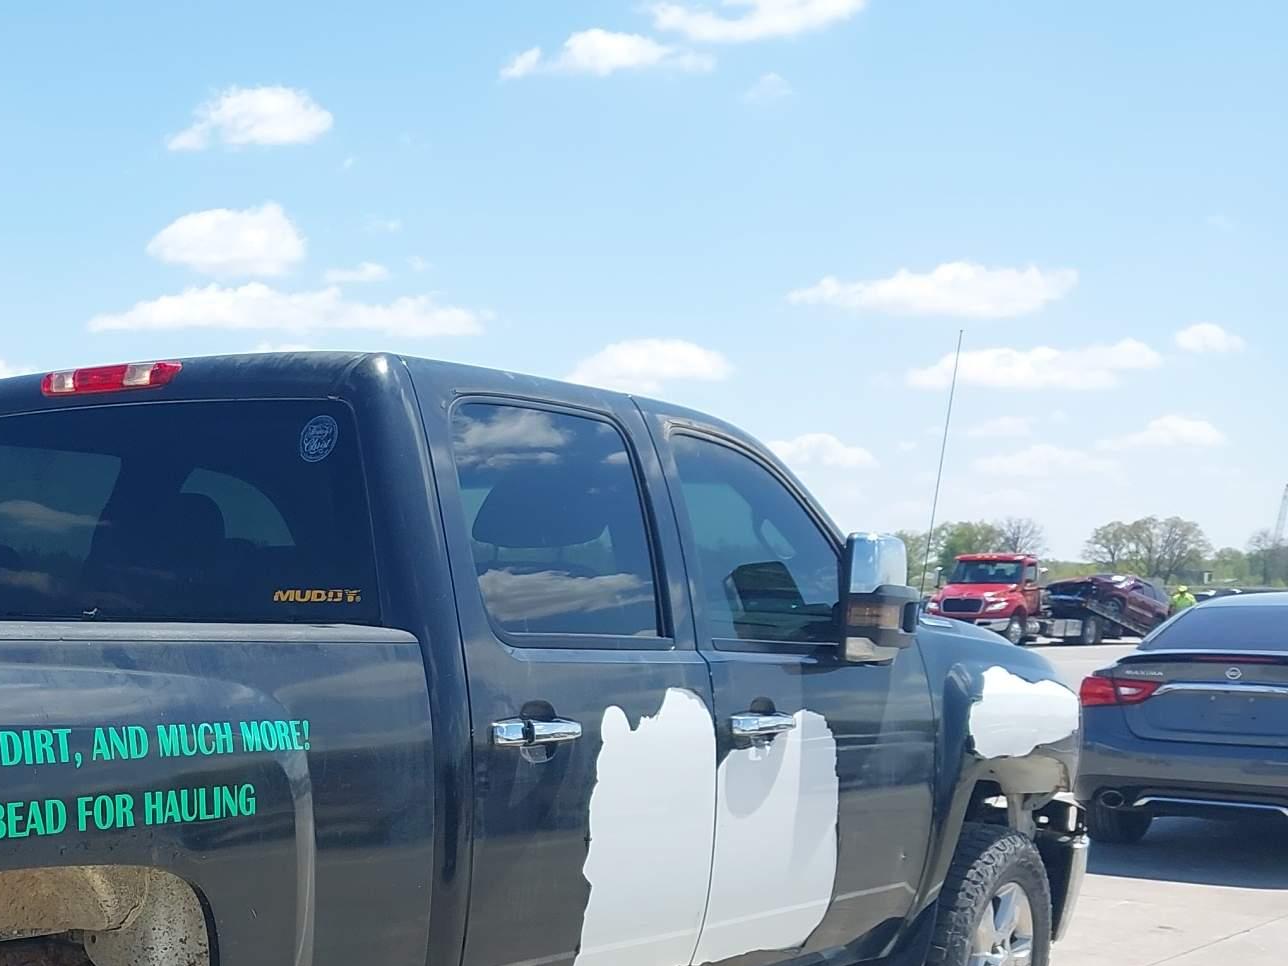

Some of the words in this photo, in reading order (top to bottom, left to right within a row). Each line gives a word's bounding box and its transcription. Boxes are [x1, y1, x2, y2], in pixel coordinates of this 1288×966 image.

[0, 728, 82, 768] DIRT,
[92, 725, 150, 761] AND
[157, 721, 235, 758] MUCH
[239, 719, 311, 752] MORE!
[77, 793, 135, 832] FOR
[143, 783, 257, 826] HAULING
